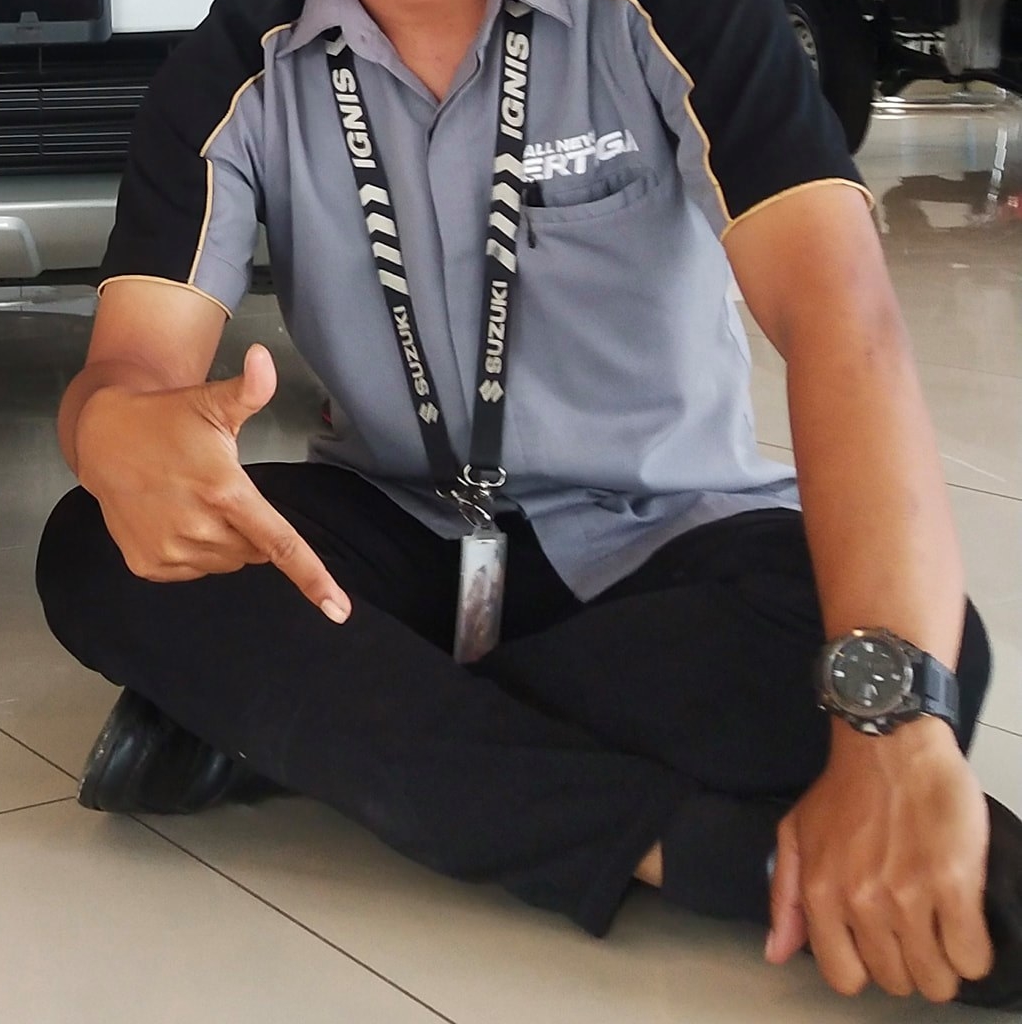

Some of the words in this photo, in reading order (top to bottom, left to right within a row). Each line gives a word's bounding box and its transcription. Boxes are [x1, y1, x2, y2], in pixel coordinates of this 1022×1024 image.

[332, 68, 376, 168] IGNIS
[501, 31, 530, 140] IGNIS
[522, 129, 639, 182] ERTGA
[523, 142, 555, 158] ALL
[393, 306, 430, 396] SUZUKI
[485, 280, 508, 374] SUZUKI
